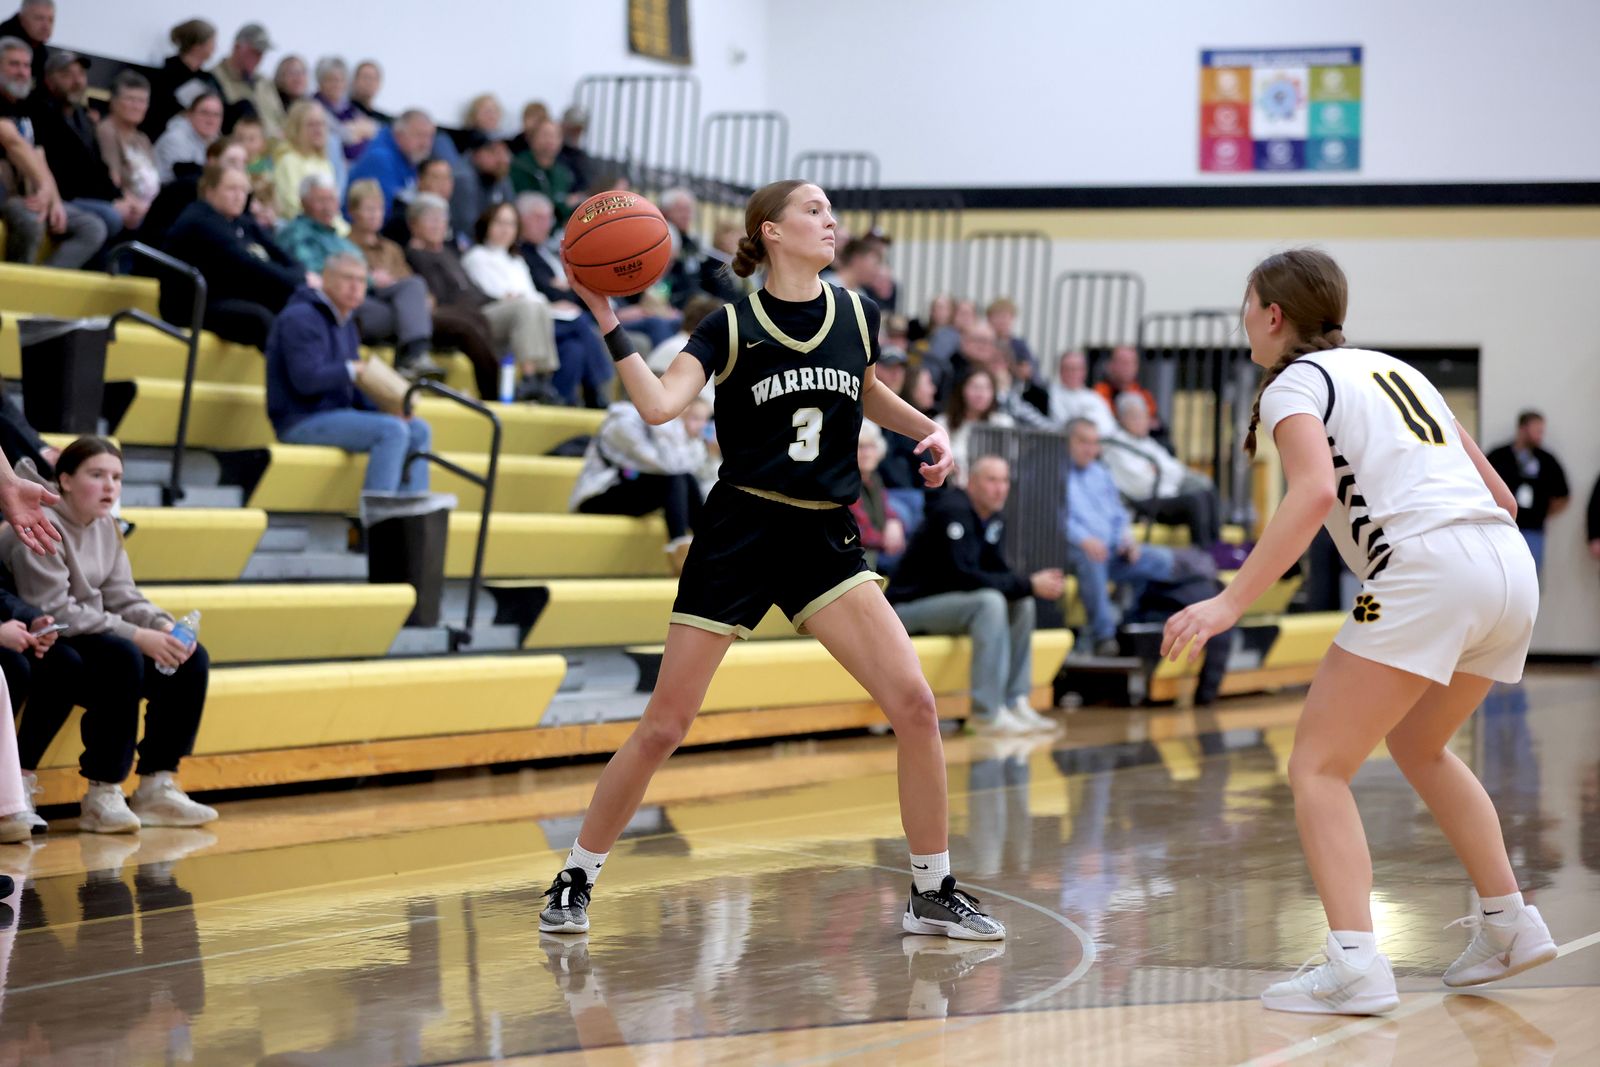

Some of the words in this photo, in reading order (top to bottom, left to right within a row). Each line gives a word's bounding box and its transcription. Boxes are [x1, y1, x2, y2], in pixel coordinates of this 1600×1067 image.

[751, 367, 861, 406] WARRIORS
[1370, 370, 1446, 446] 11
[788, 407, 823, 462] 3
